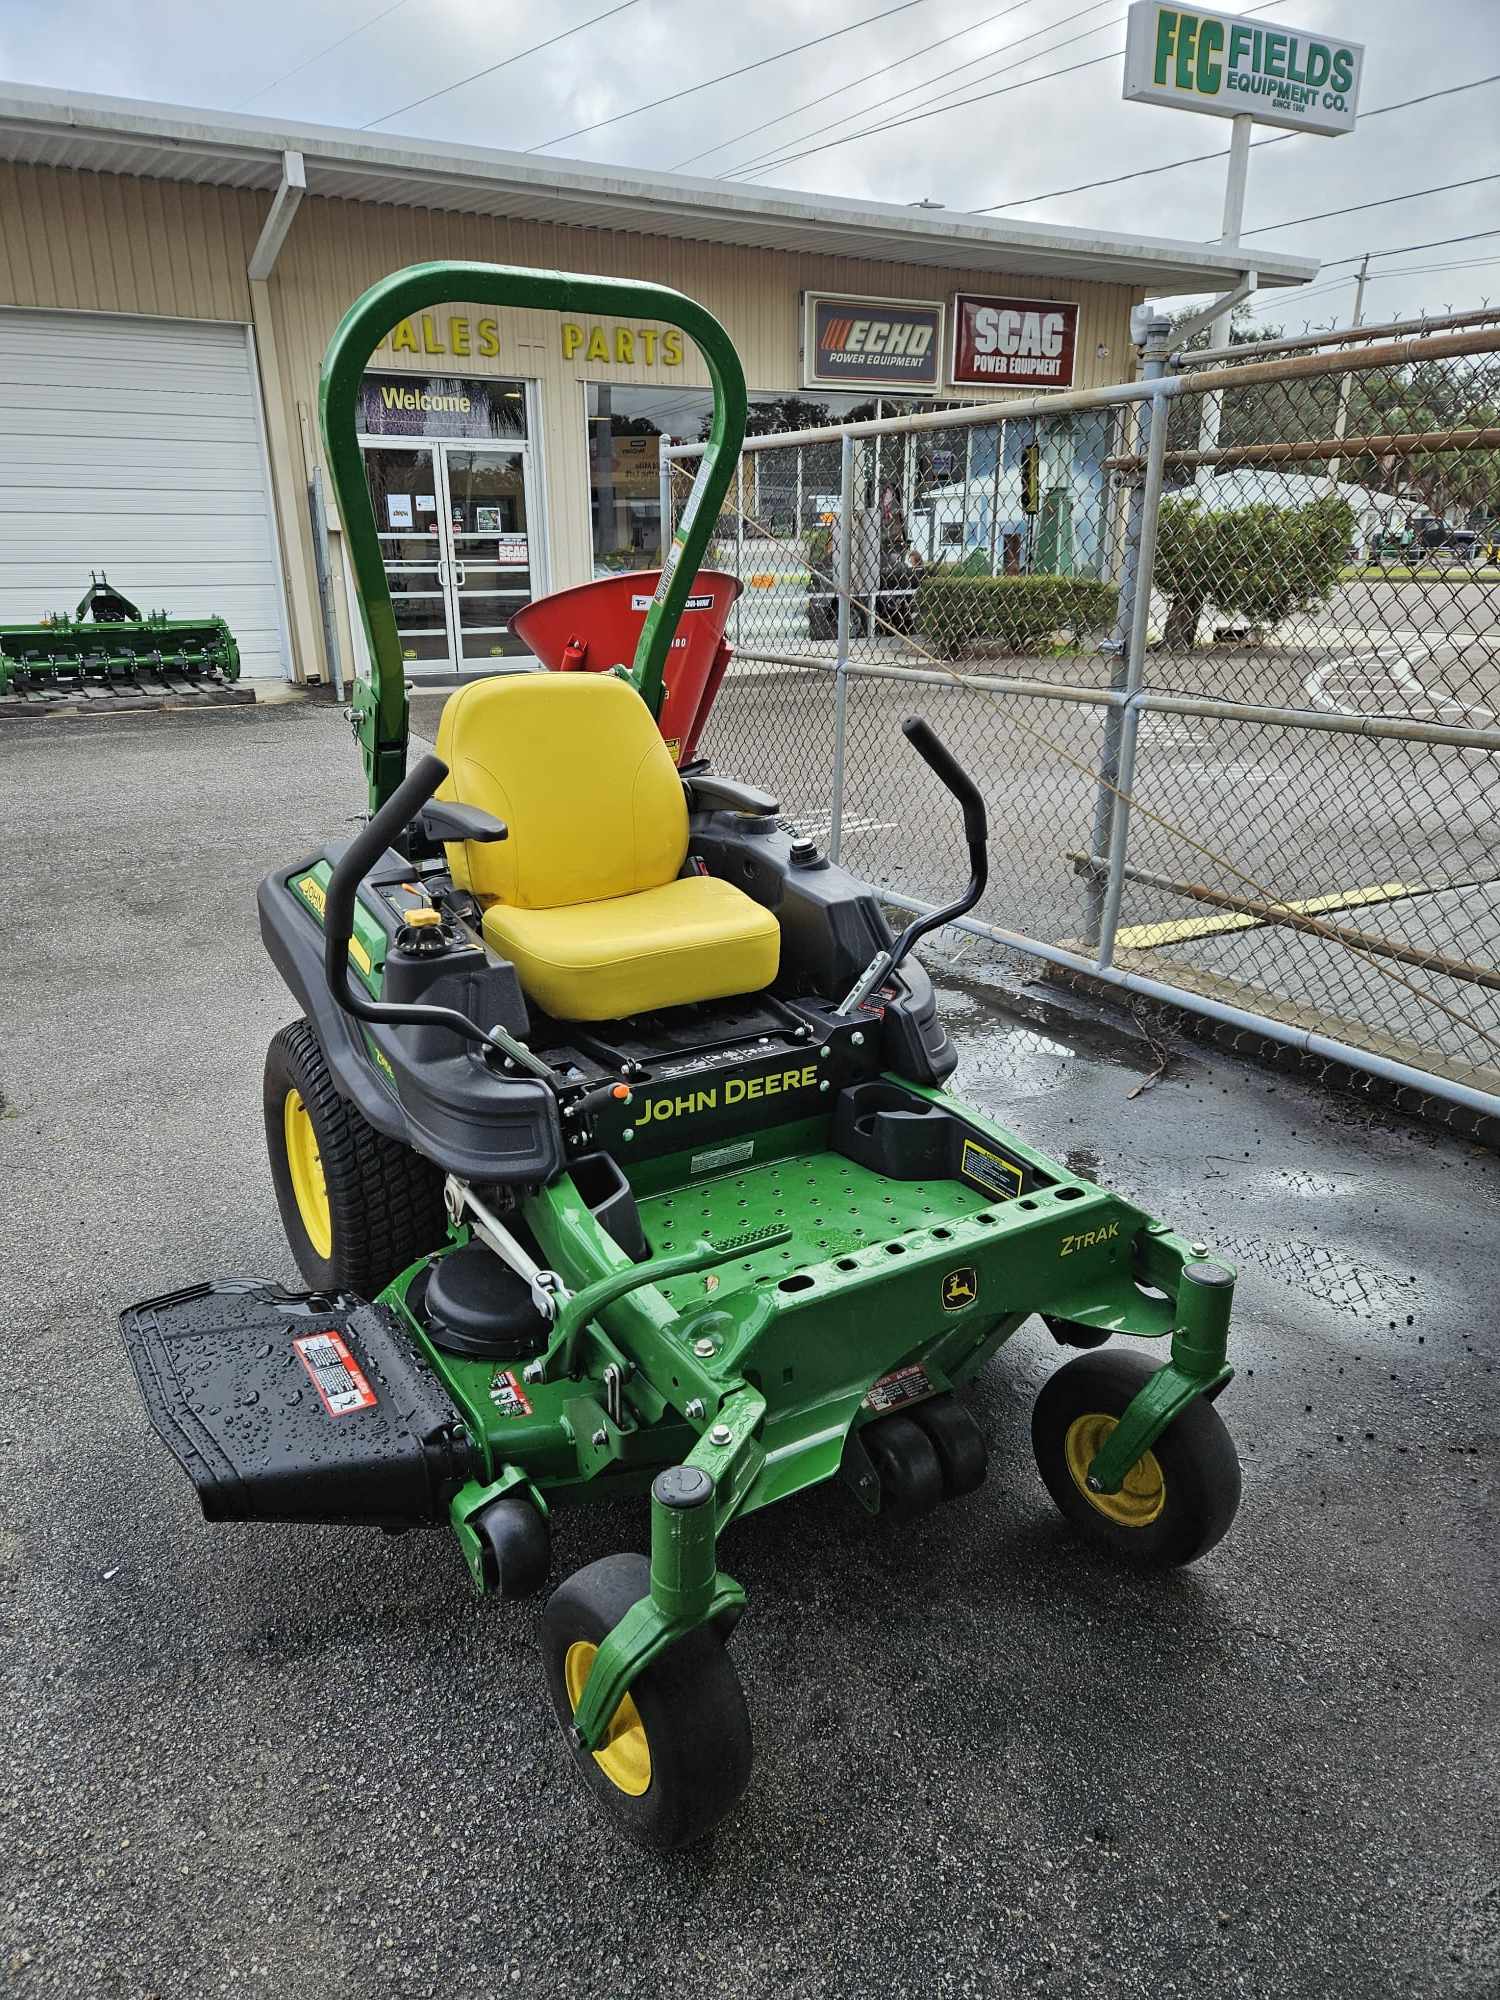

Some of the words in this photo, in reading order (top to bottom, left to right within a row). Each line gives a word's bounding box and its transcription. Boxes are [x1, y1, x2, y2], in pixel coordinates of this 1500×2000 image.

[1153, 8, 1225, 95] FEC
[1228, 24, 1354, 93] FIELDS
[1226, 70, 1319, 105] EQUIPMENT
[1323, 92, 1348, 112] CO.
[1272, 98, 1291, 110] SINCE
[376, 314, 501, 357] ALES
[561, 323, 685, 366] PARTS
[844, 320, 933, 356] ECHO
[975, 307, 1064, 357] SCAG
[829, 352, 866, 364] POWER
[867, 355, 924, 368] EQUIPMENT
[973, 356, 1008, 374] POWER
[1009, 358, 1062, 376] EQUIPMENT
[381, 386, 471, 413] Welcome
[635, 1088, 717, 1126] JOHN
[725, 1065, 818, 1105] DEERE
[1059, 1220, 1120, 1257] ZTRAK
